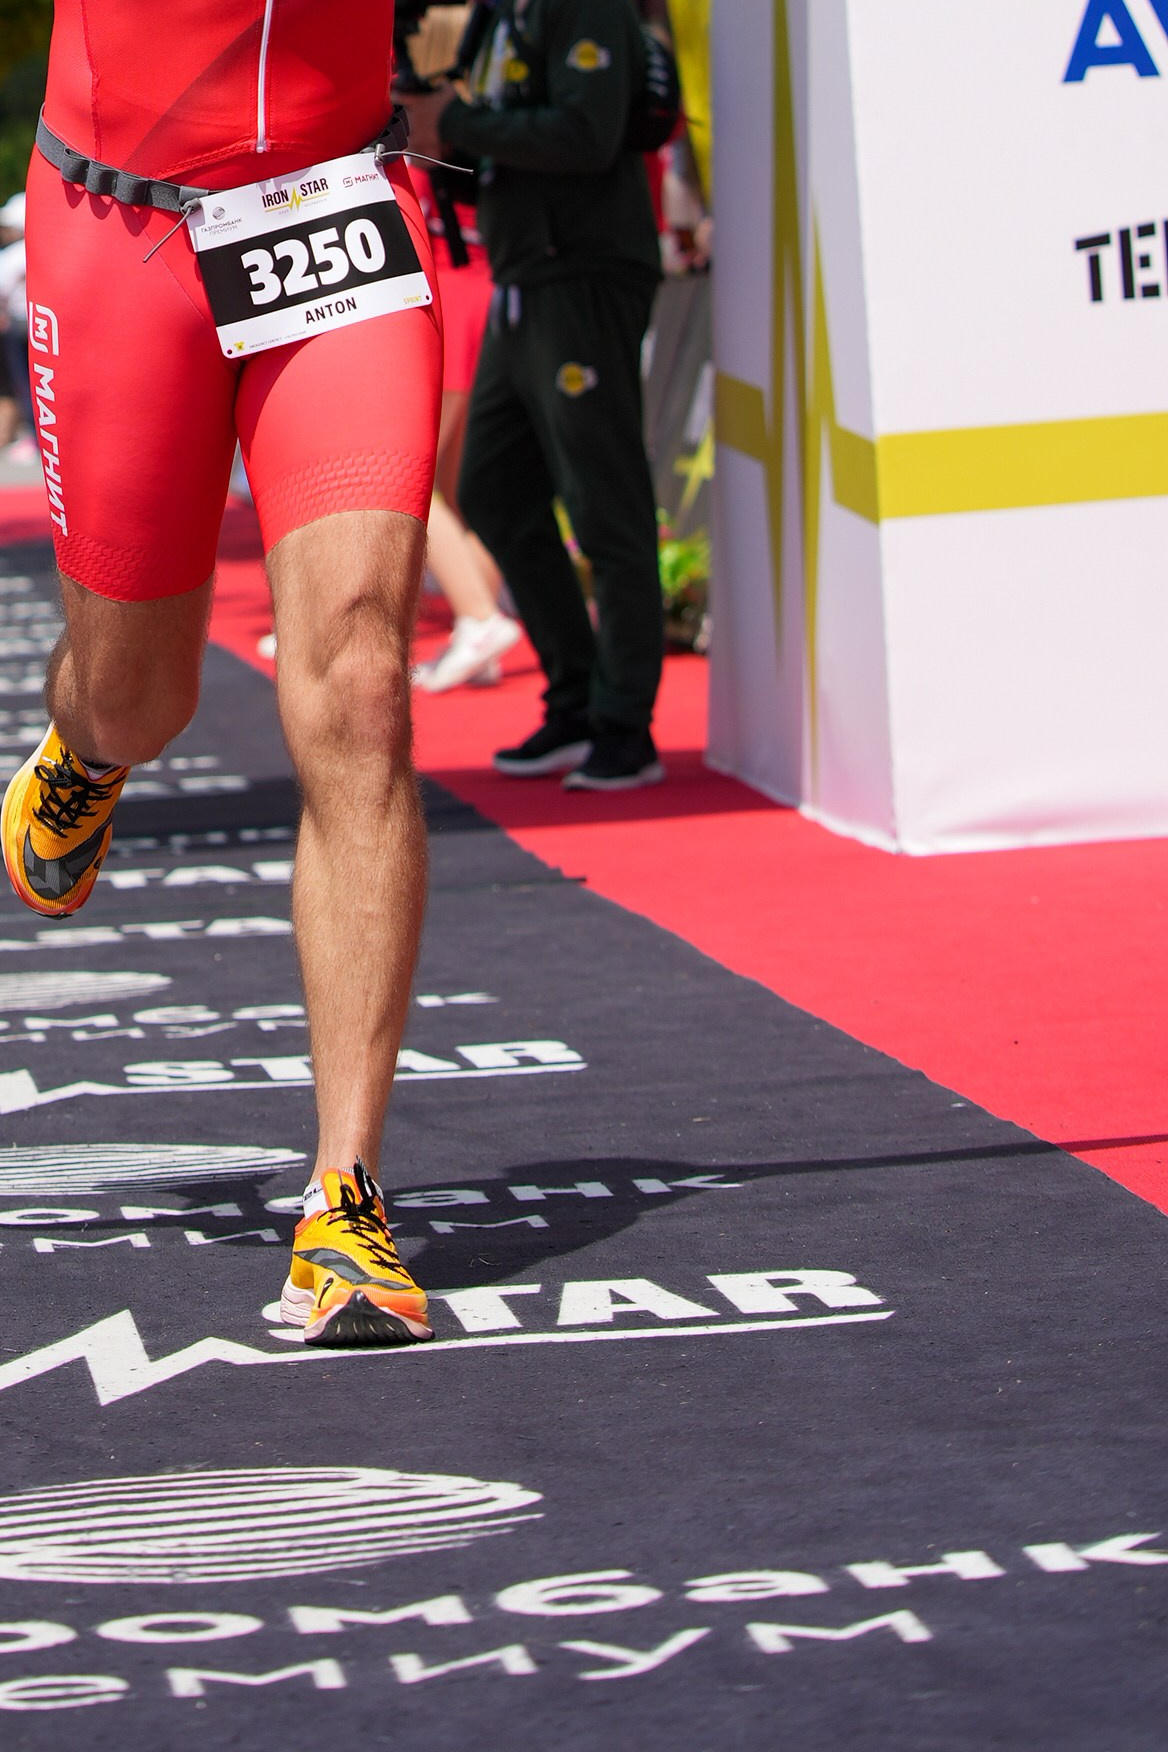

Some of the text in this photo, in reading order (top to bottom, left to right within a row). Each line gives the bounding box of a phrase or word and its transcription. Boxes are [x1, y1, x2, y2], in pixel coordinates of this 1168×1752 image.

[261, 189, 290, 208] IRON
[299, 177, 330, 197] STAR
[240, 218, 387, 306] 3250
[1074, 218, 1168, 303] TE
[304, 296, 358, 325] ANTON
[33, 362, 68, 537] МАГНИТ
[261, 1269, 886, 1344] TAR
